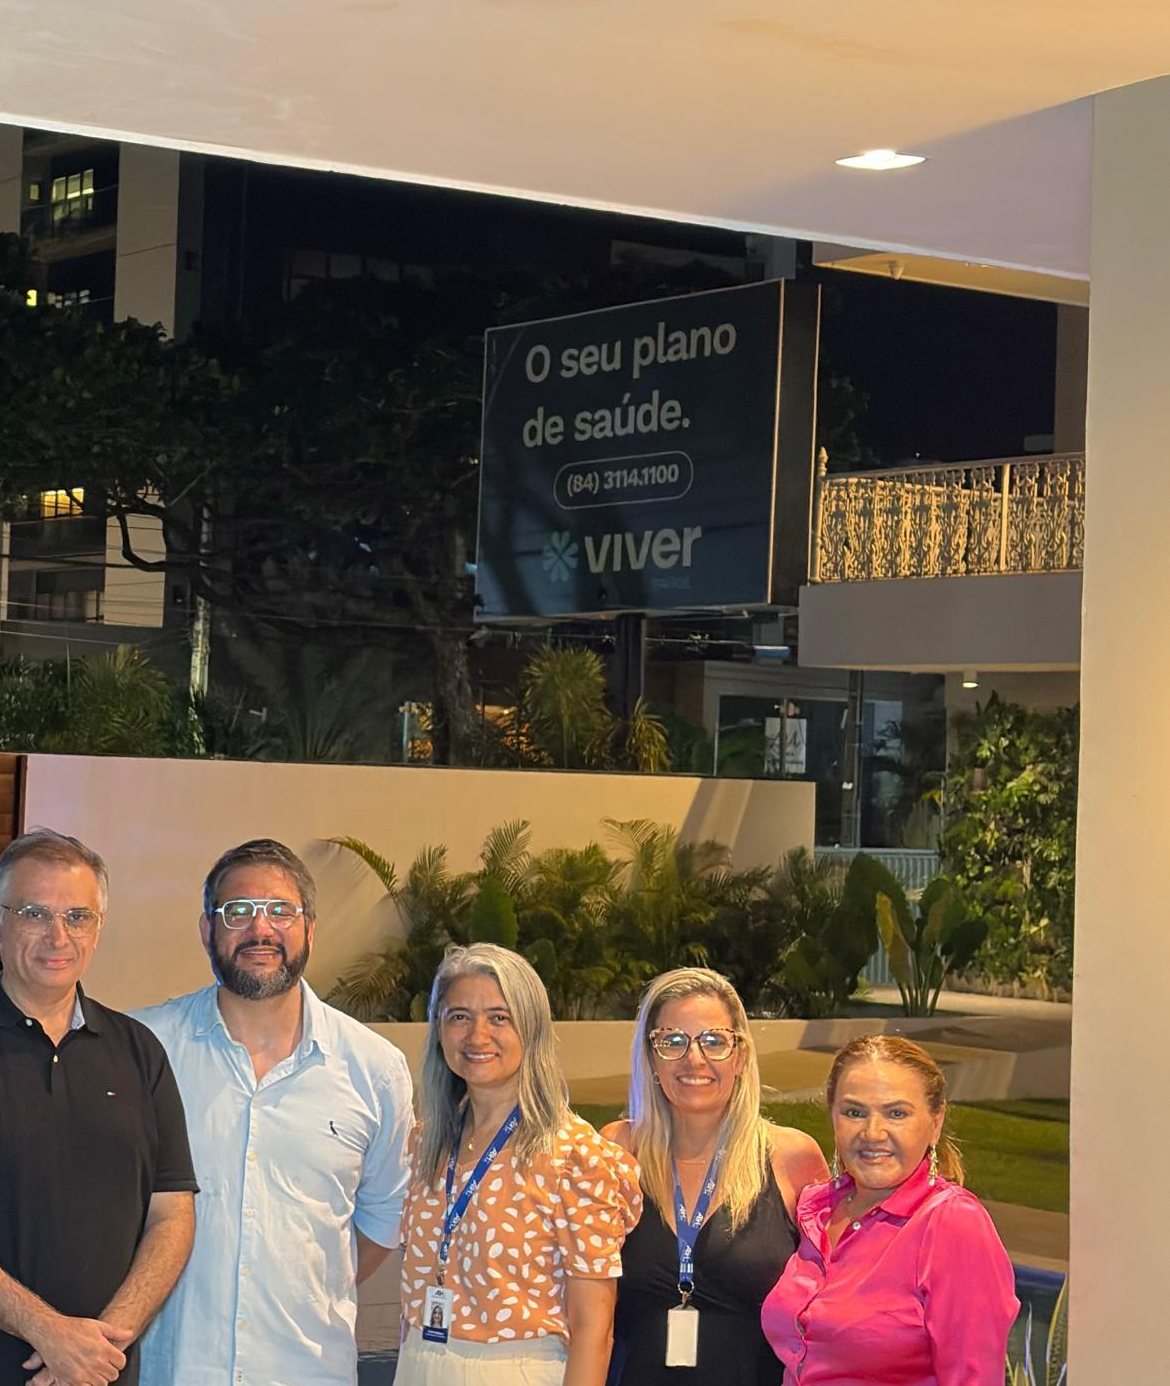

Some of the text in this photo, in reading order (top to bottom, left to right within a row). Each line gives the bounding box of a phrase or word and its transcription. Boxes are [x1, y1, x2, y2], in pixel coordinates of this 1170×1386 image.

[525, 322, 736, 383] O seu plano
[523, 389, 690, 448] de saúde.
[567, 464, 679, 497] (84) 3114.1100
[584, 525, 702, 573] viver
